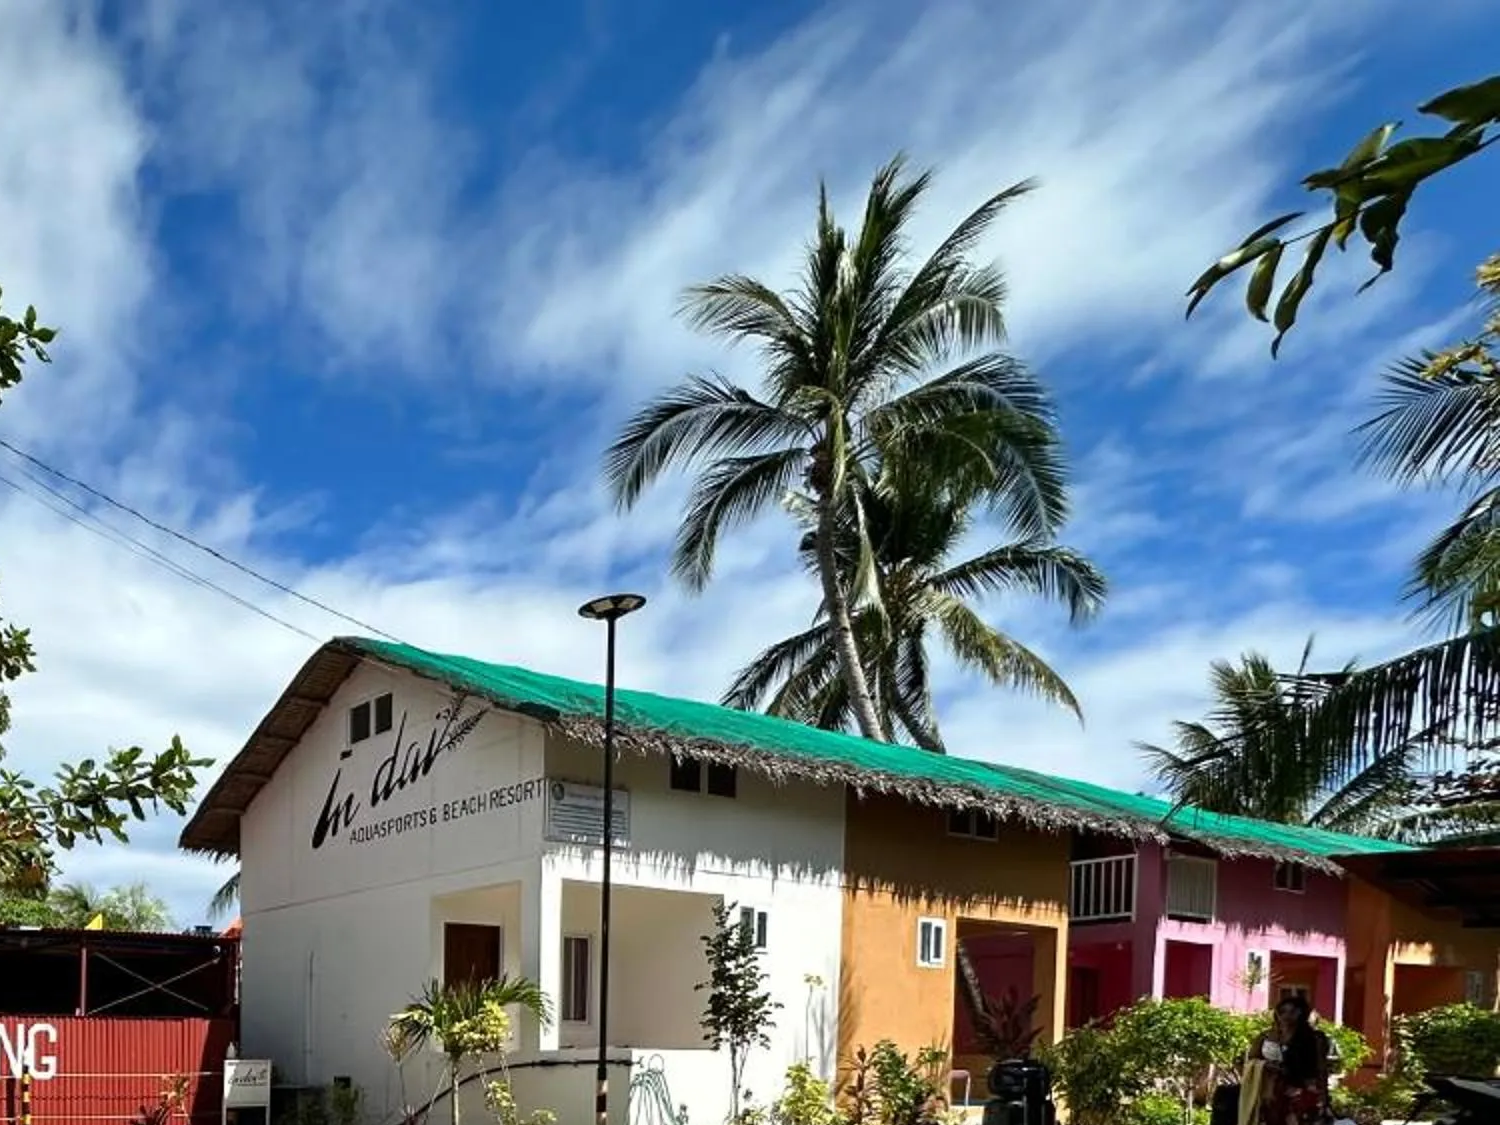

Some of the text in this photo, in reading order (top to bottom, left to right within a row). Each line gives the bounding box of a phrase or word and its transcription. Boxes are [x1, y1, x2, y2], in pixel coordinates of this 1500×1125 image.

[350, 779, 543, 844] AQUASPORTS & BEACH RESORT
